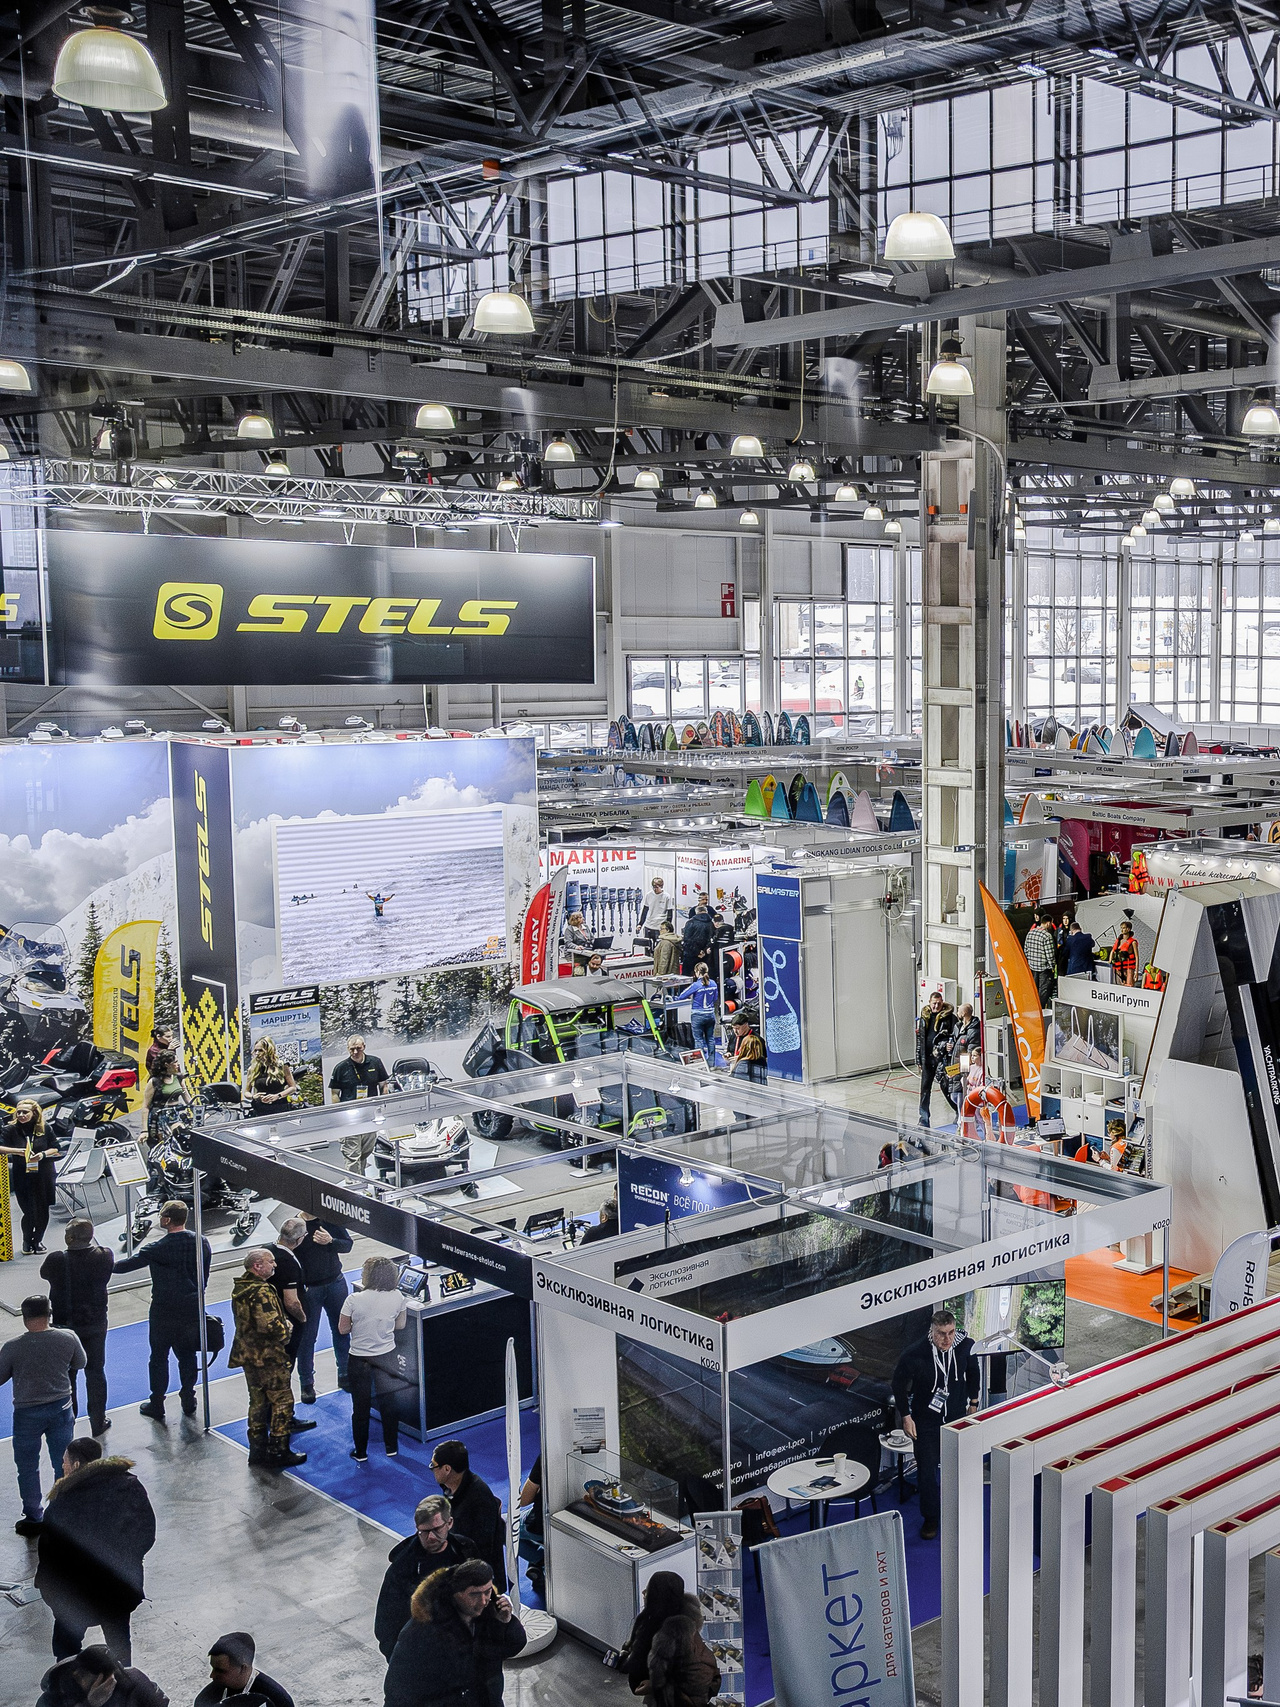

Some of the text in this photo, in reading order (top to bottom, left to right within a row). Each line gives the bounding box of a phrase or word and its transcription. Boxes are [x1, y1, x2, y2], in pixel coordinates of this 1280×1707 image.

[237, 594, 518, 635] STELS
[1123, 814, 1146, 823] Company
[194, 770, 214, 951] STELS
[677, 855, 707, 867] YAMARINE
[711, 856, 751, 867] YAMARINE
[840, 848, 860, 857] LIDIAN
[862, 844, 882, 853] TOOLS
[757, 885, 799, 898] SAILMASTER
[254, 988, 315, 1006] STELS
[1091, 988, 1150, 1009] ВайПиГрупп
[119, 944, 142, 1091] TELS
[1264, 1045, 1280, 1105] YACHTPARKING
[631, 1183, 668, 1203] RECON
[673, 1194, 691, 1209] ВСЁ
[320, 1192, 371, 1225] LOWRANCE
[441, 1242, 507, 1272] www.lowrance-eholot.com
[649, 1259, 710, 1283] Эксклюзивная
[649, 1273, 693, 1291] логистика
[860, 1232, 1071, 1310] Эксклюзивная логистика
[536, 1271, 715, 1352] Эксклюзивная логистика
[876, 1550, 897, 1678] для катеров и яхт
